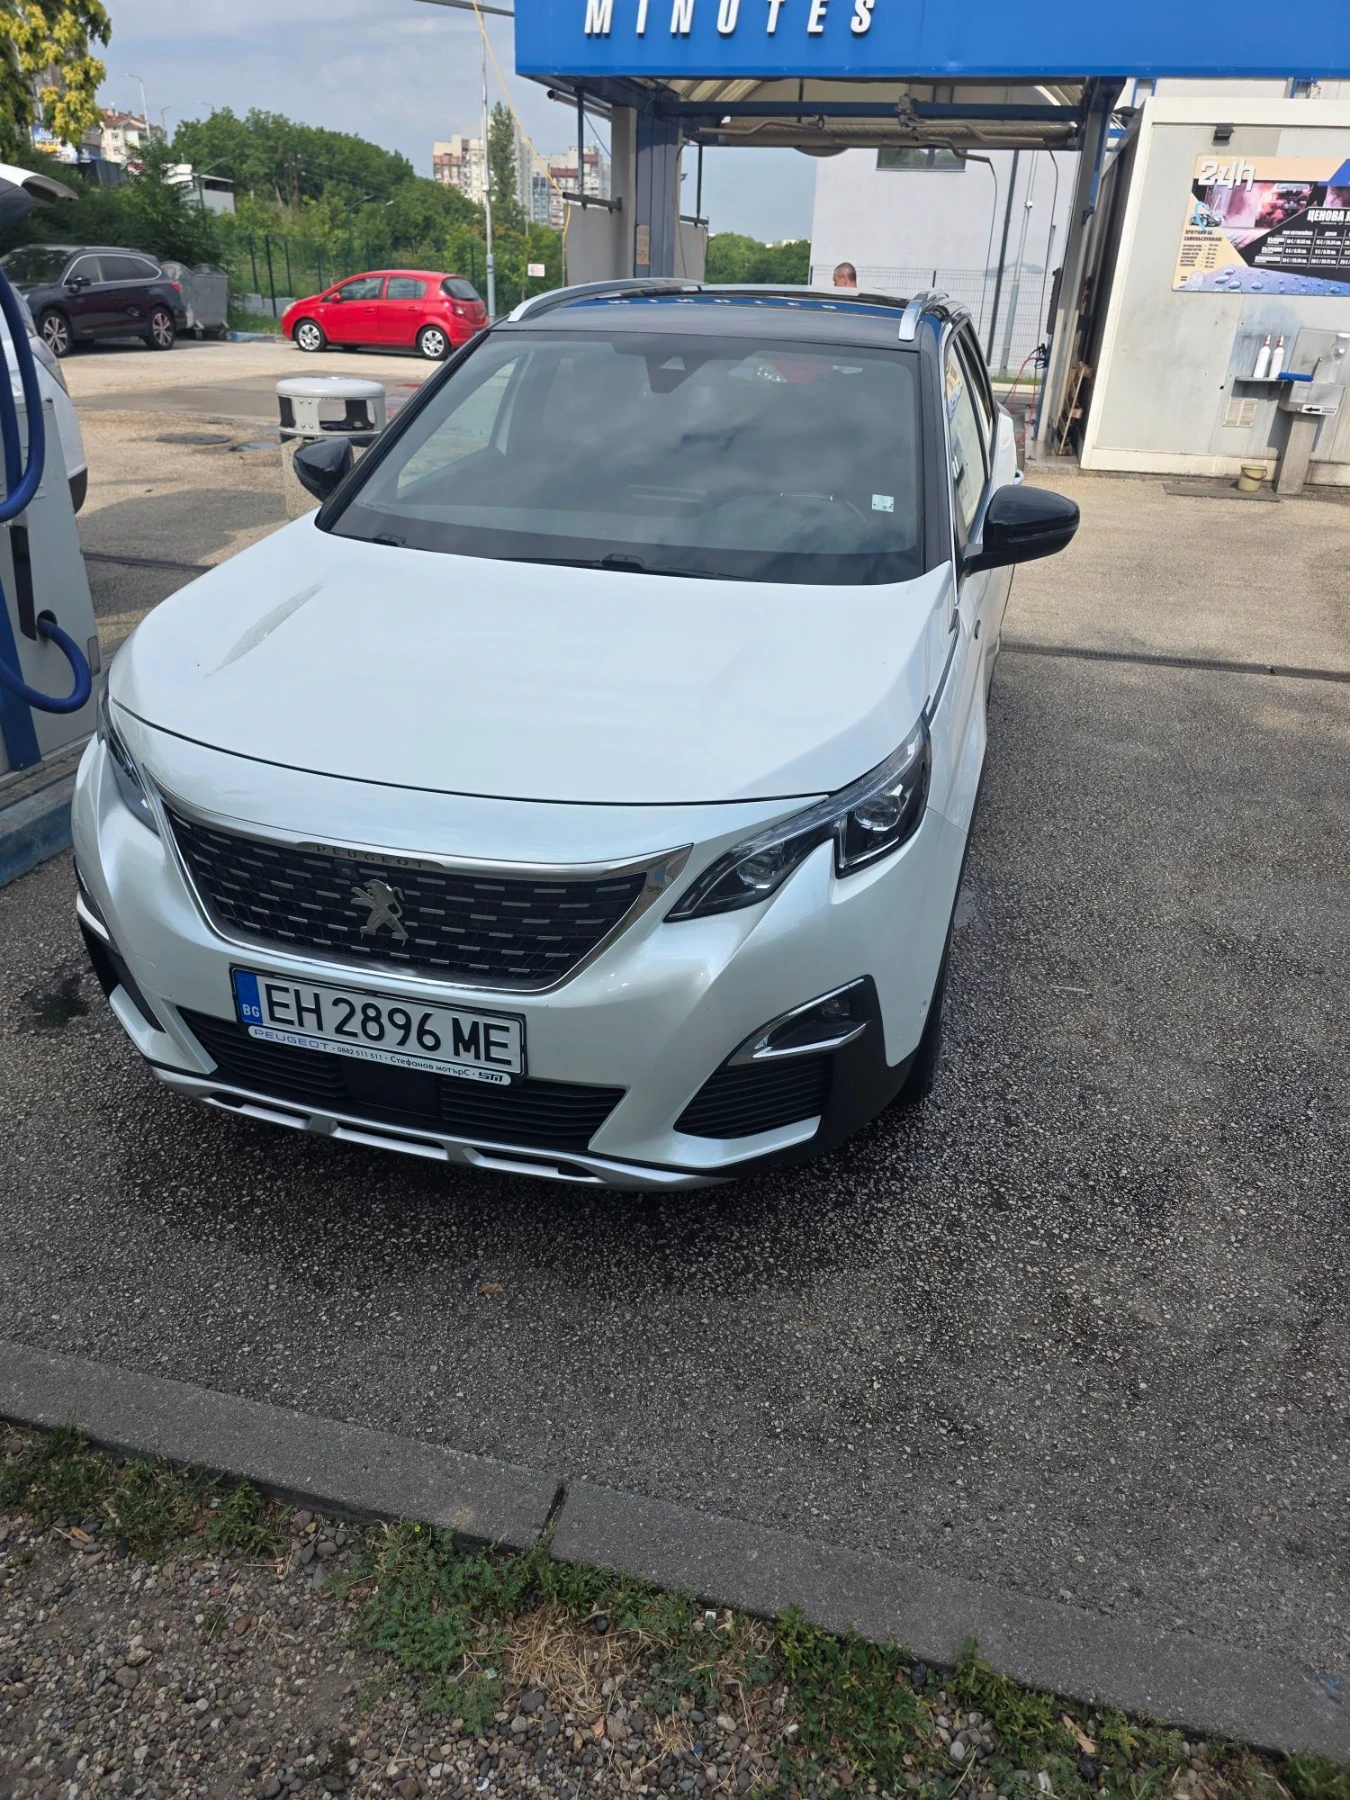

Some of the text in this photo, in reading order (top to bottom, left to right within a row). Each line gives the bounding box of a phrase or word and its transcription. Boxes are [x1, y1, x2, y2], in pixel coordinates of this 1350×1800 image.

[584, 0, 876, 36] MINUTES
[1198, 158, 1256, 192] 24h
[1307, 209, 1345, 222] ЦЕНОВА
[316, 844, 425, 869] PEUGEOT
[242, 982, 512, 1066] BG EH 2896 ME
[253, 1028, 330, 1051] PEUGEOT
[356, 1048, 368, 1058] 511
[370, 1051, 383, 1061] 511
[390, 1056, 433, 1070] Стефанов
